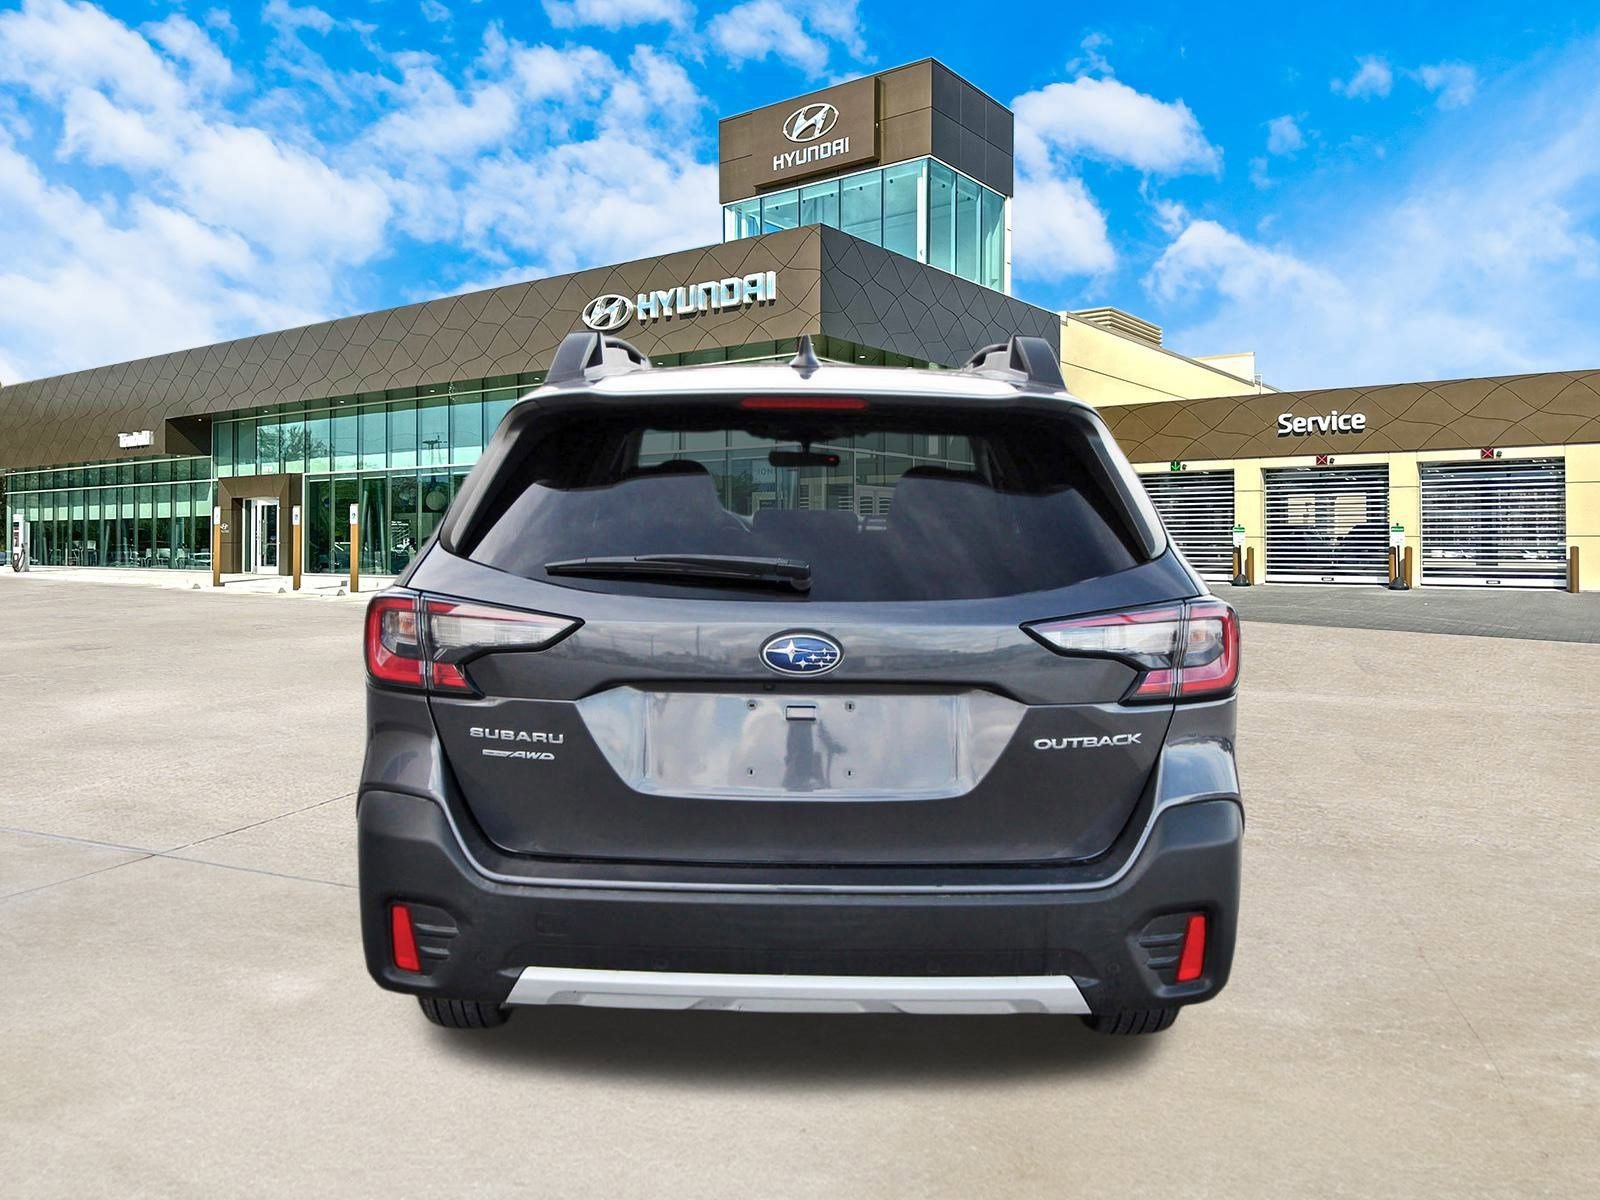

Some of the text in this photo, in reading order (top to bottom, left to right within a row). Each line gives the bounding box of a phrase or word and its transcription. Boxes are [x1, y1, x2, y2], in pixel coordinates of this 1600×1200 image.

[773, 137, 849, 171] HYUNDAI
[637, 271, 776, 321] HYUNDAI
[1278, 410, 1366, 435] Service
[469, 727, 564, 744] SUBARU
[1033, 732, 1142, 750] OUTBACK
[509, 750, 555, 761] AWD
